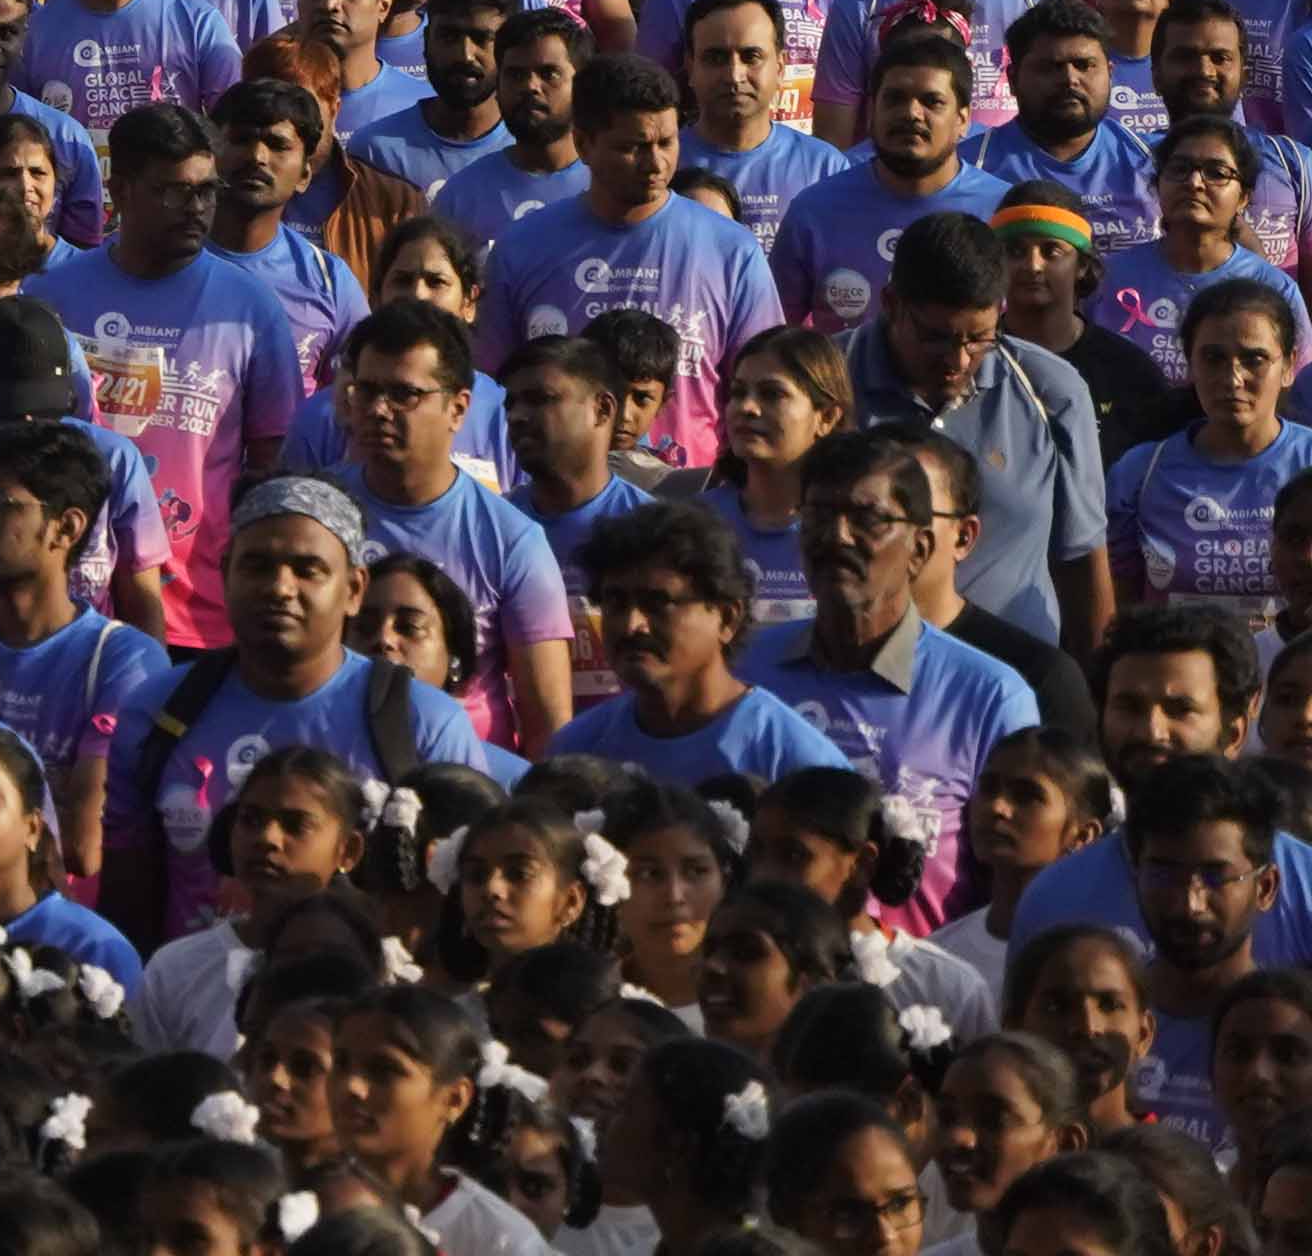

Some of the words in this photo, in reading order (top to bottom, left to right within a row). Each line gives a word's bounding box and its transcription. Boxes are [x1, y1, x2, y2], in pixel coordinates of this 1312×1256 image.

[85, 72, 146, 88] GLOBAL
[86, 87, 140, 102] GRACE
[1120, 113, 1169, 128] GLOB
[98, 377, 148, 408] 2421
[181, 396, 217, 419] RUN
[1196, 540, 1270, 556] GLOBA
[1196, 577, 1274, 593] CANCE
